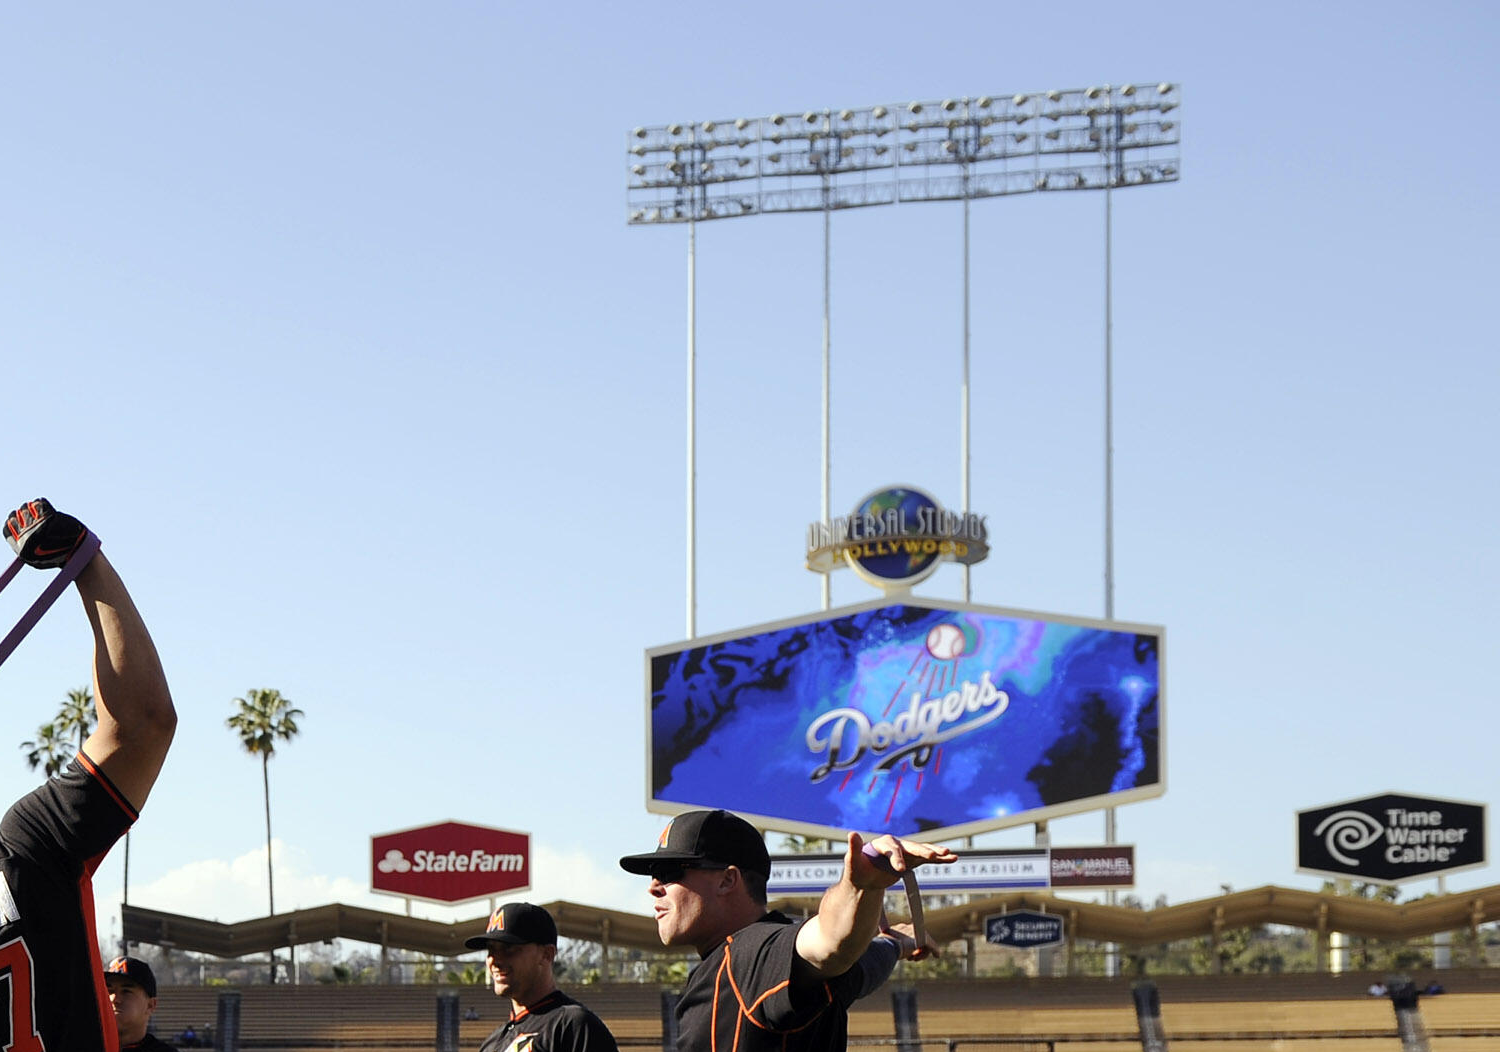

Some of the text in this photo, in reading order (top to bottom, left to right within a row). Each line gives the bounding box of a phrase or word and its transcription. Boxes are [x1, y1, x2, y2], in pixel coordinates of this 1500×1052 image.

[808, 505, 988, 552] UNIVERSAL STUDIOS
[832, 539, 968, 564] HOLLYWOOD
[806, 670, 1010, 784] Dodgers
[1385, 808, 1443, 827] Time
[1384, 827, 1468, 845] Warner
[1384, 845, 1451, 864] Cable
[772, 867, 838, 880] WELCOM
[961, 862, 1035, 875] STADIUM
[1051, 857, 1132, 871] SAN MANUEL
[1013, 921, 1060, 931] SECURITY
[1013, 932, 1054, 941] BENEFIT
